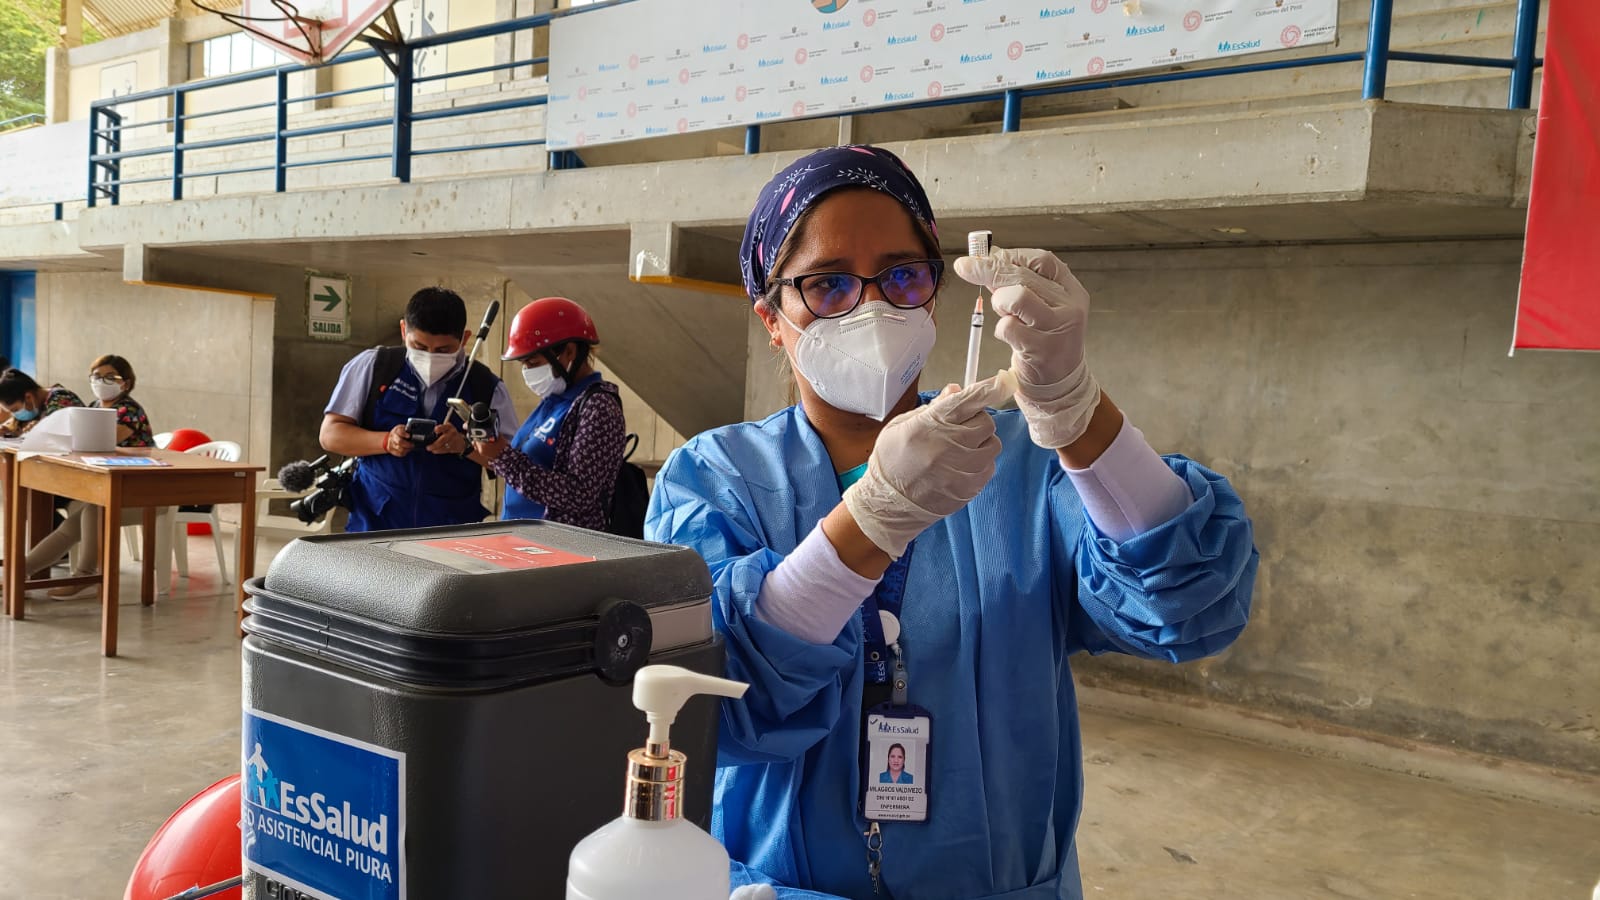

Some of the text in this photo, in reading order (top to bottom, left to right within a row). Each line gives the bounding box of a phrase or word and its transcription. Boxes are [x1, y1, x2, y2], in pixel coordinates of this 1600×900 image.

[1051, 6, 1075, 17] EsSalud
[1138, 24, 1165, 36] EsSalud
[1231, 39, 1261, 51] EsSalud
[970, 53, 993, 63] EsSalud
[1047, 68, 1071, 79] EsSalud
[312, 321, 342, 334] SALIDA
[892, 725, 919, 735] EsSalud
[280, 780, 388, 855] EsSalud
[257, 814, 342, 864] ASISTENCIAL
[346, 848, 393, 884] PIURA
